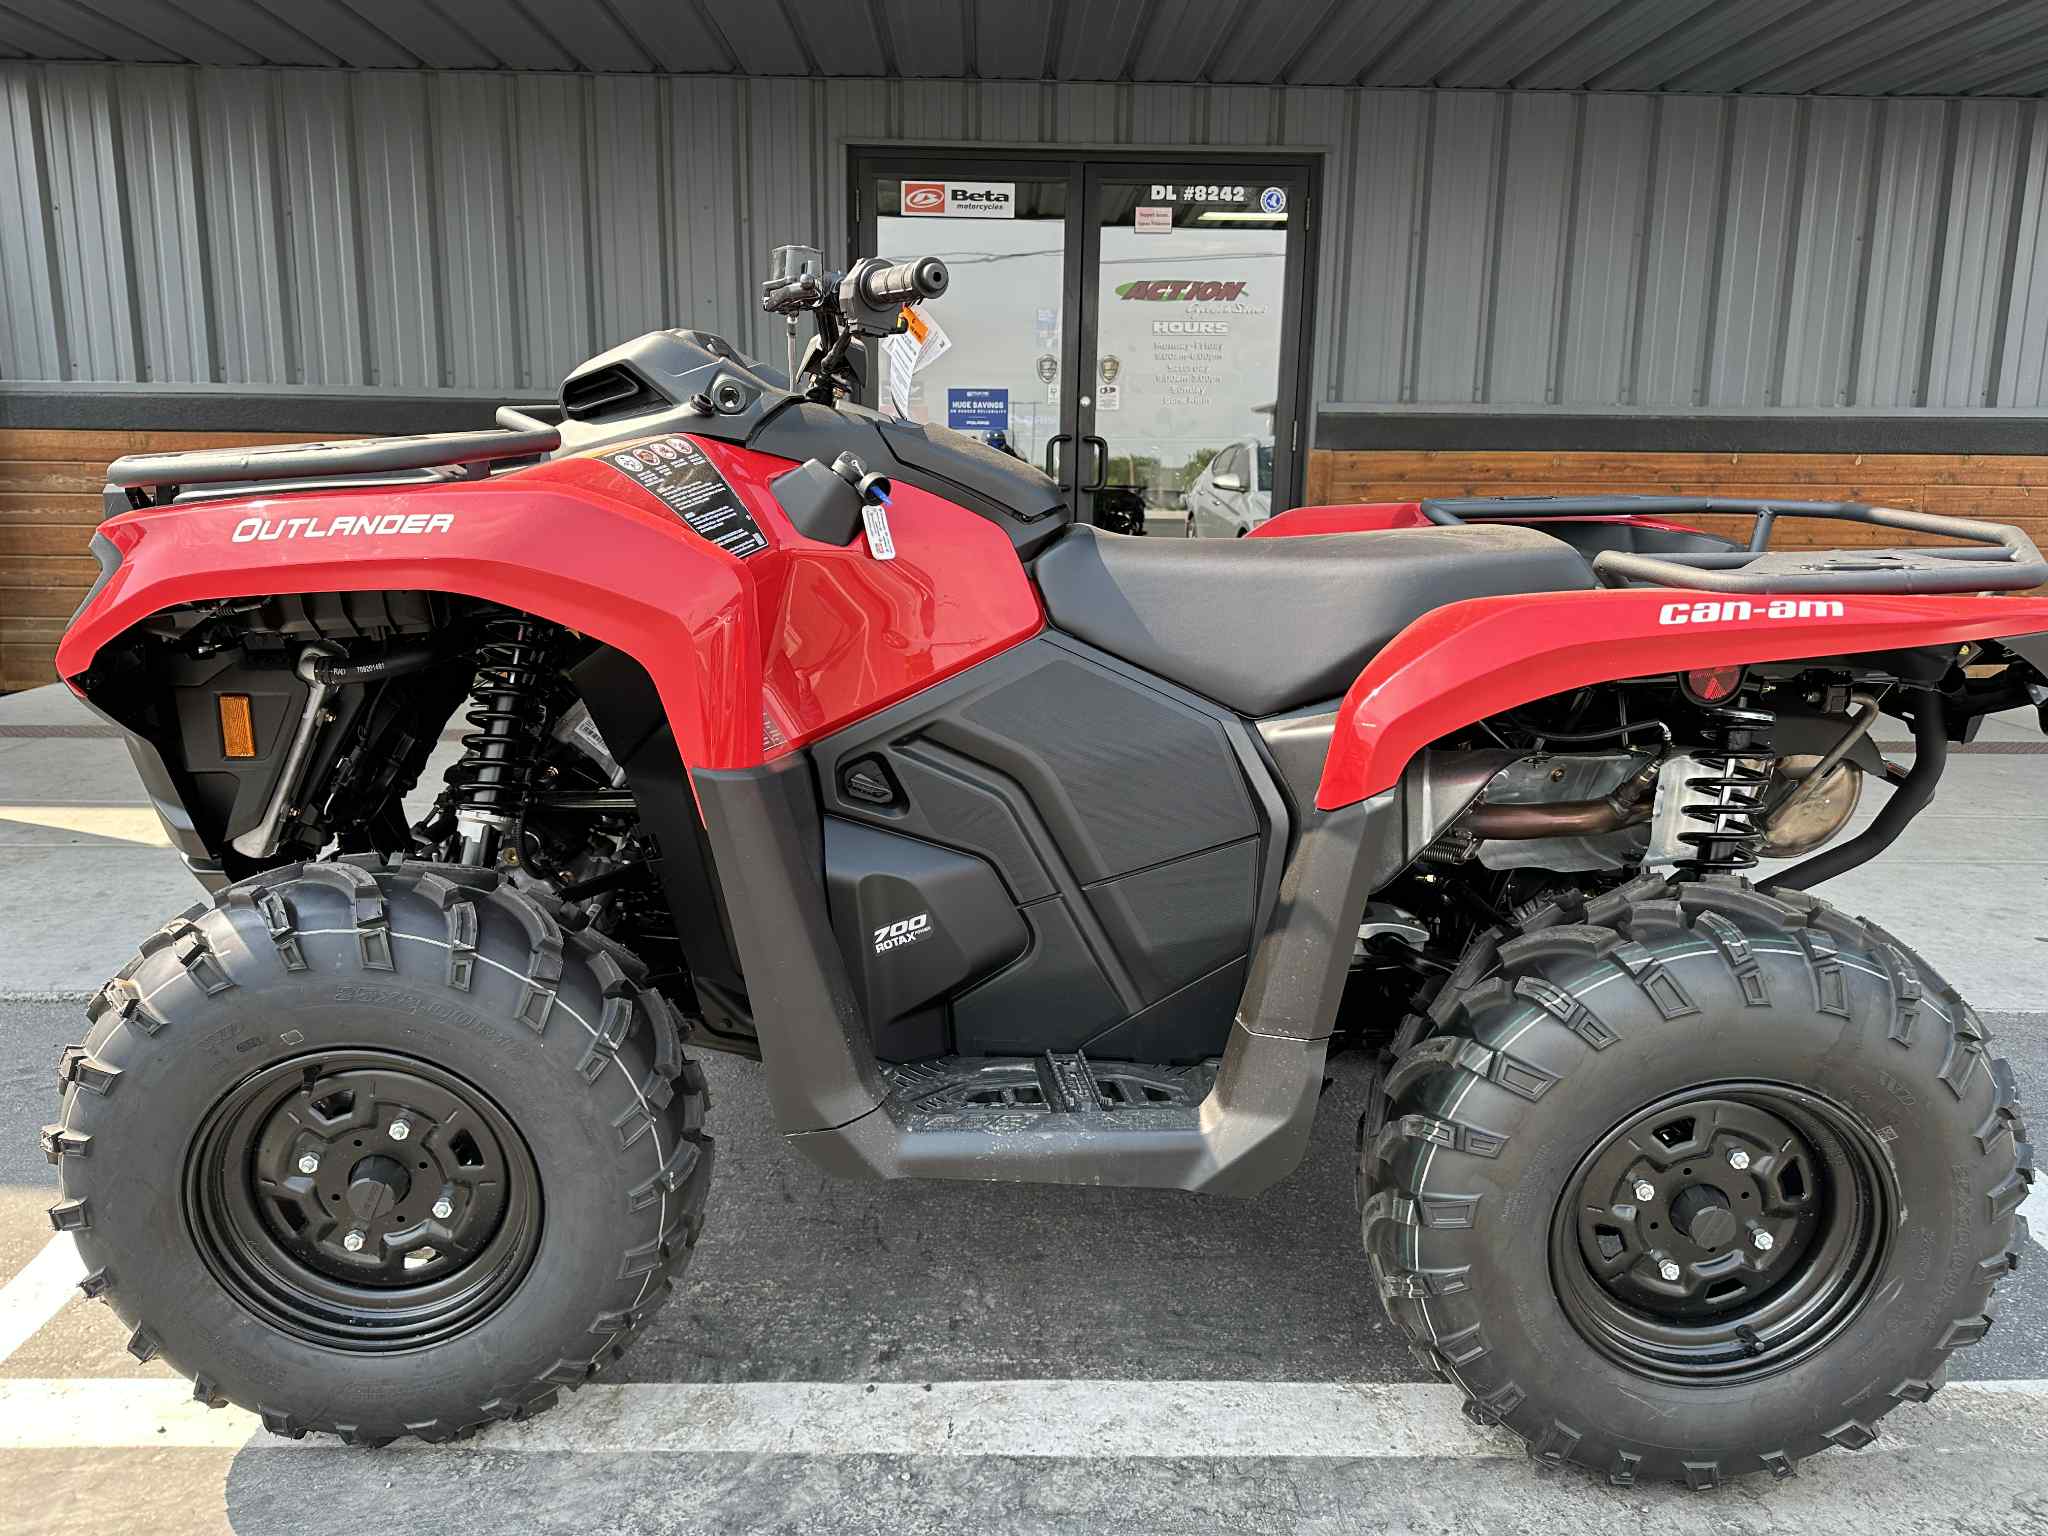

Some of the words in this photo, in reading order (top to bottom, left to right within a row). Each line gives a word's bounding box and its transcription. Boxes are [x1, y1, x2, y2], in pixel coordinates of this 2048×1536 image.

[951, 189, 1009, 202] Beta
[1150, 184, 1177, 201] DL
[1183, 185, 1245, 202] #8242
[956, 203, 1003, 211] motorcycles
[1121, 280, 1247, 301] ACTION
[1152, 320, 1230, 335] HOURS
[232, 513, 454, 543] OUTLANDER
[1659, 600, 1844, 625] can-am
[874, 913, 927, 944] 700
[875, 931, 917, 954] ROTAX
